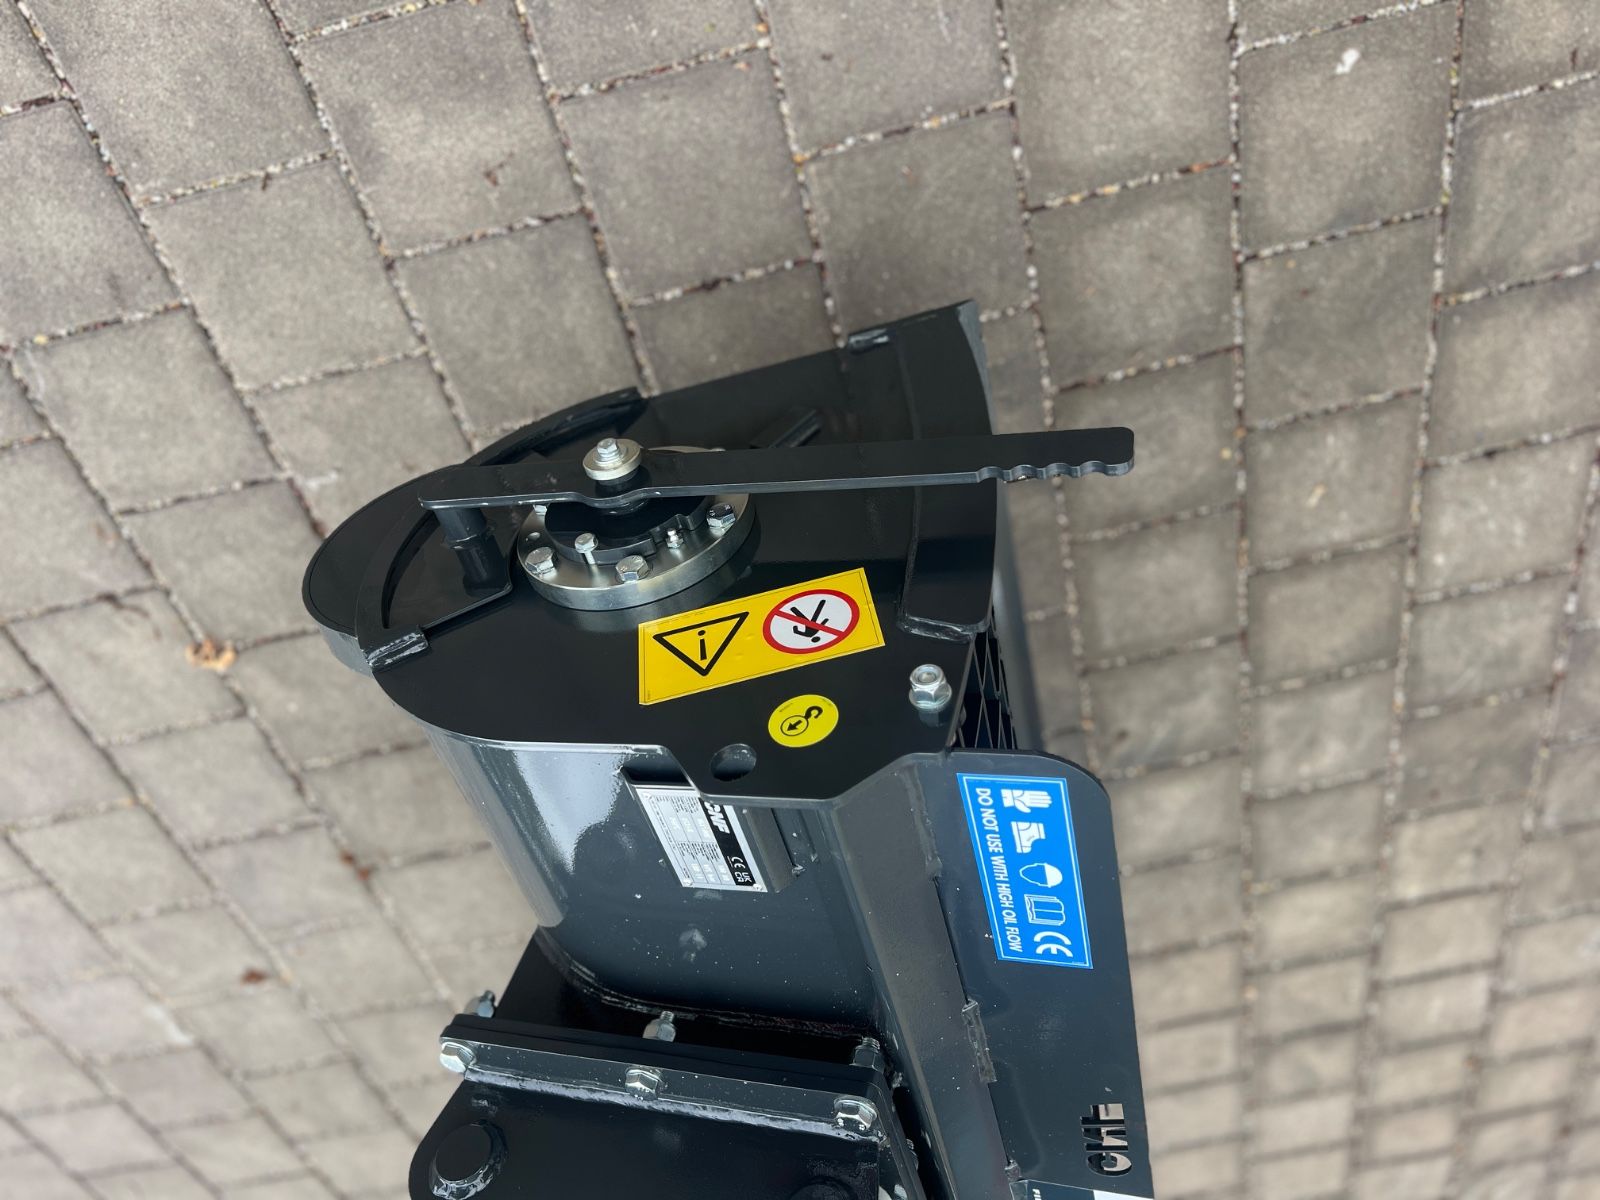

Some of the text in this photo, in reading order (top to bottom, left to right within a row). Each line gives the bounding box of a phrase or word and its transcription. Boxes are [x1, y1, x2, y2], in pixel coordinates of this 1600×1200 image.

[731, 856, 746, 869] CE
[976, 788, 1023, 952] DO NOT USE WITH HIGH OIL FLOW
[1033, 931, 1073, 957] CE
